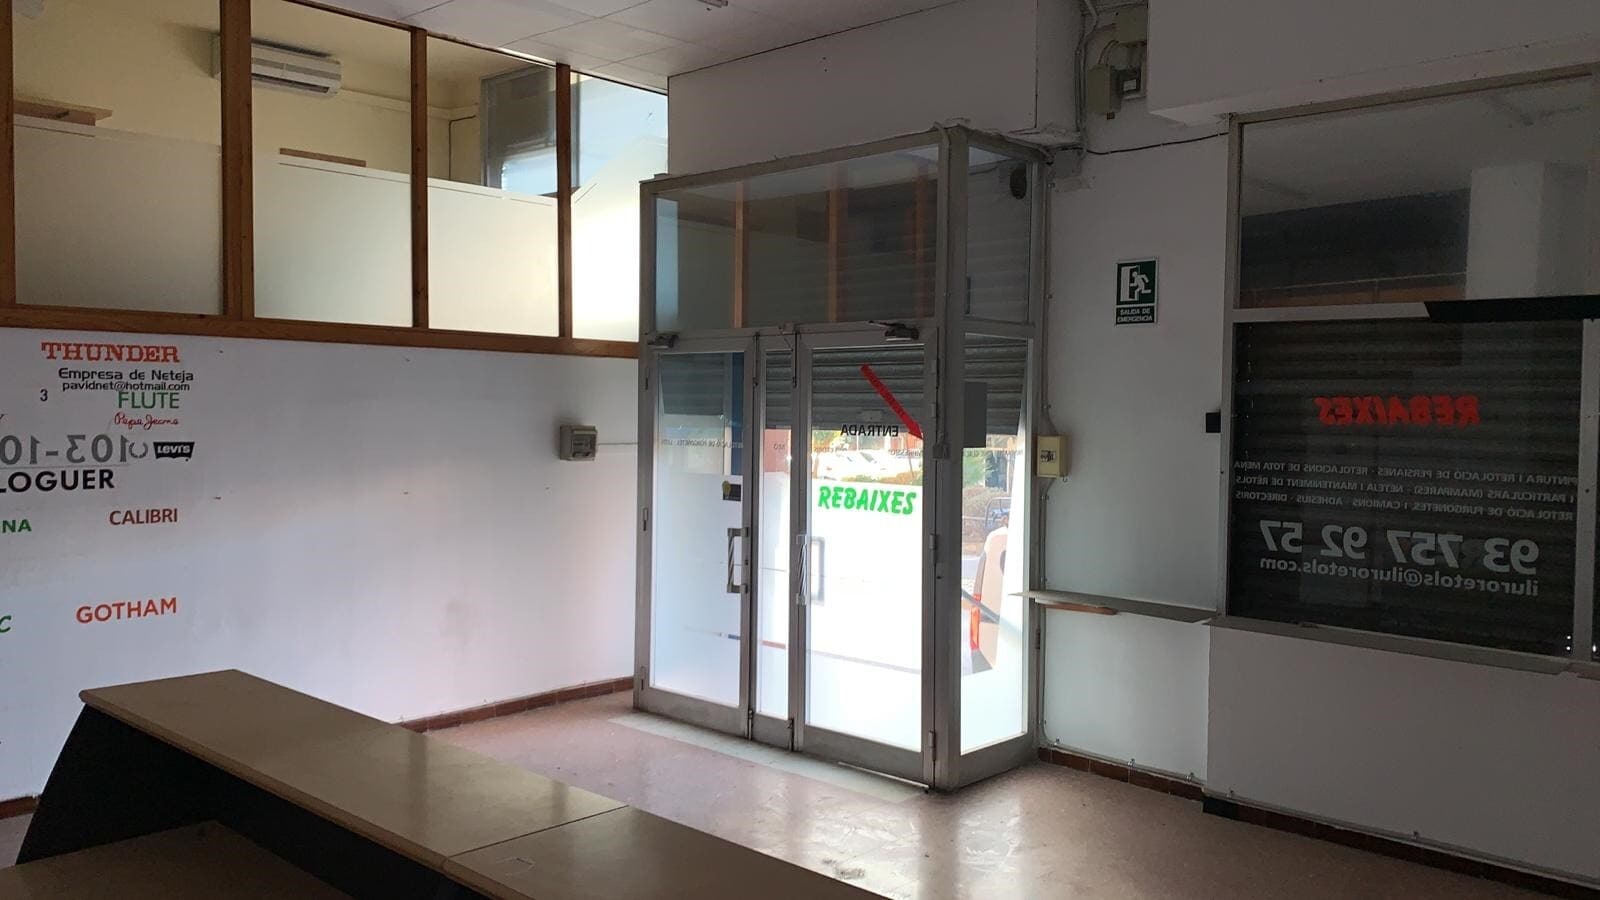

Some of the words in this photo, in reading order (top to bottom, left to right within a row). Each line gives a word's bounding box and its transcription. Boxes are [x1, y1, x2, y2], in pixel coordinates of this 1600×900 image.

[41, 342, 180, 363] THUNDER
[58, 368, 123, 381] Empresa
[130, 369, 145, 380] de
[152, 370, 194, 383] Neteja
[62, 381, 190, 392] pavidnet@hotmail.com
[40, 389, 48, 402] 3
[118, 392, 180, 409] FLUTE
[818, 485, 917, 516] REBAIXES
[109, 508, 178, 525] CALIBRI
[76, 597, 177, 624] GOTHAM
